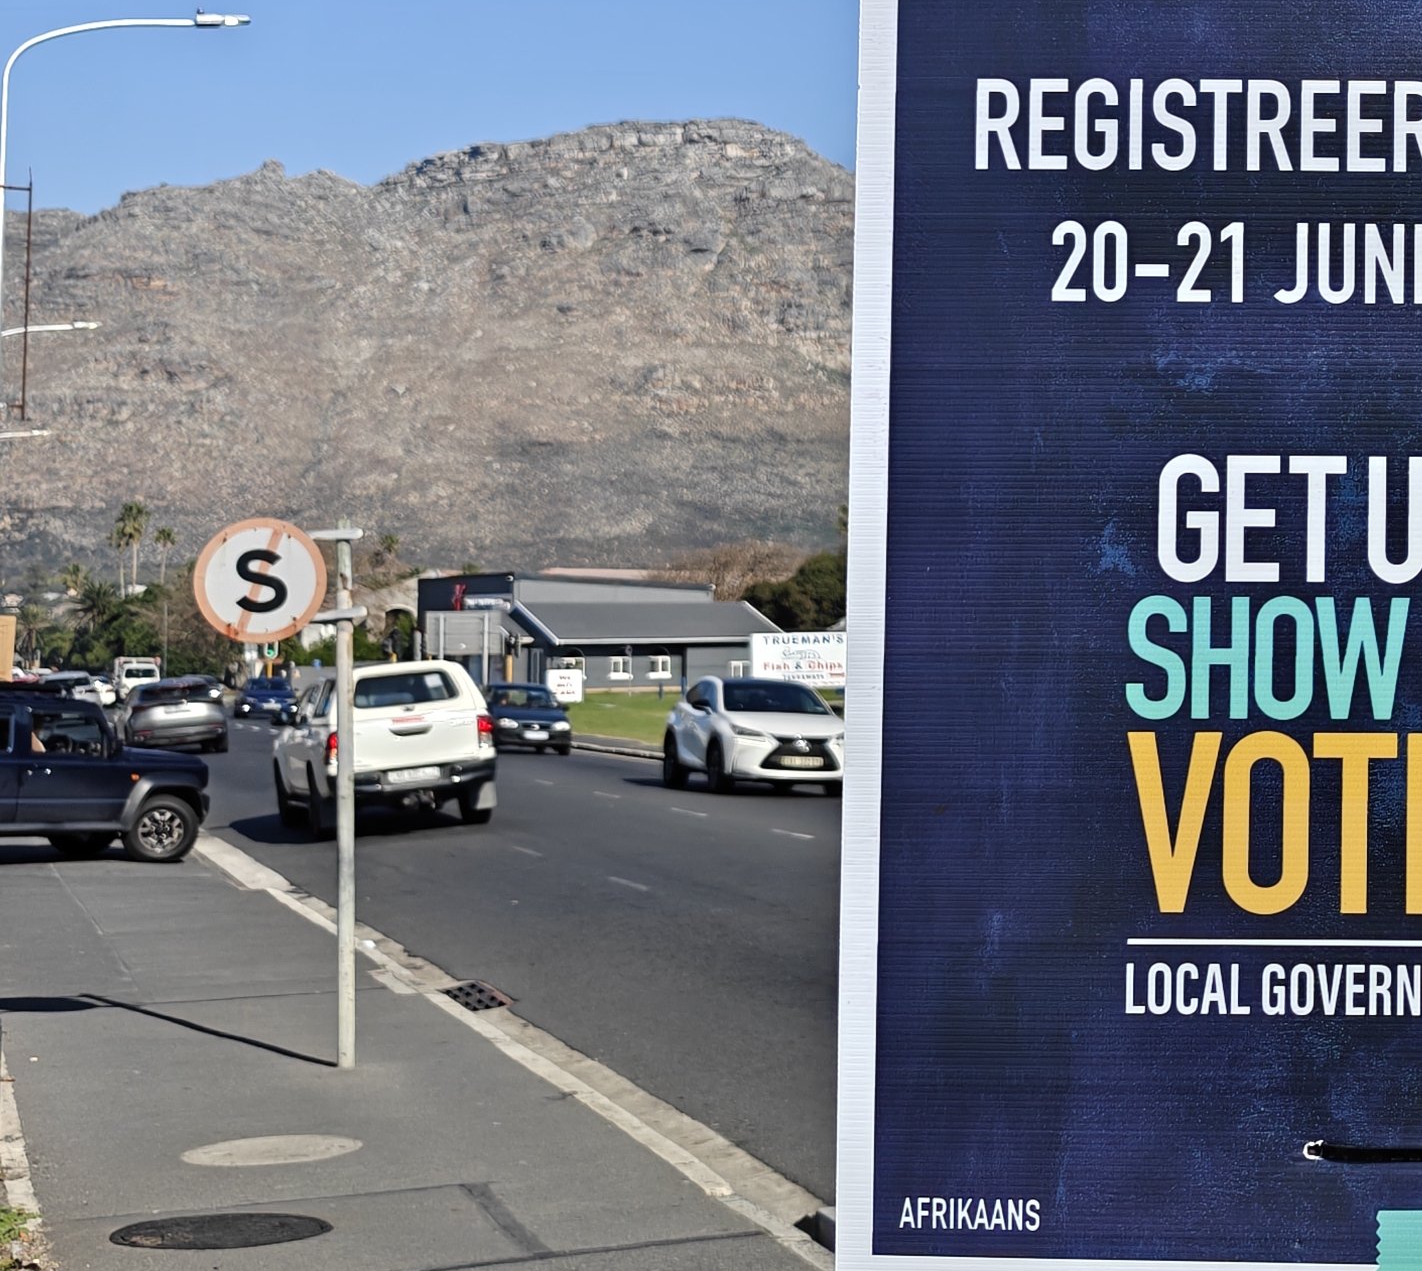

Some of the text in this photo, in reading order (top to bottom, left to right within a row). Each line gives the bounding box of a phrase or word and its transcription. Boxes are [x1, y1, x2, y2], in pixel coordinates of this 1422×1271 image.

[1050, 220, 1247, 305] 20-21
[1157, 453, 1348, 583] GET
[235, 548, 289, 614] S
[763, 634, 844, 646] TRUEMAN'S
[763, 662, 790, 671] Fish
[808, 660, 843, 672] Chips
[1125, 595, 1410, 720] SHOW
[1125, 962, 1251, 1015] LOCAL
[899, 1197, 1041, 1231] AFRIKAANS
